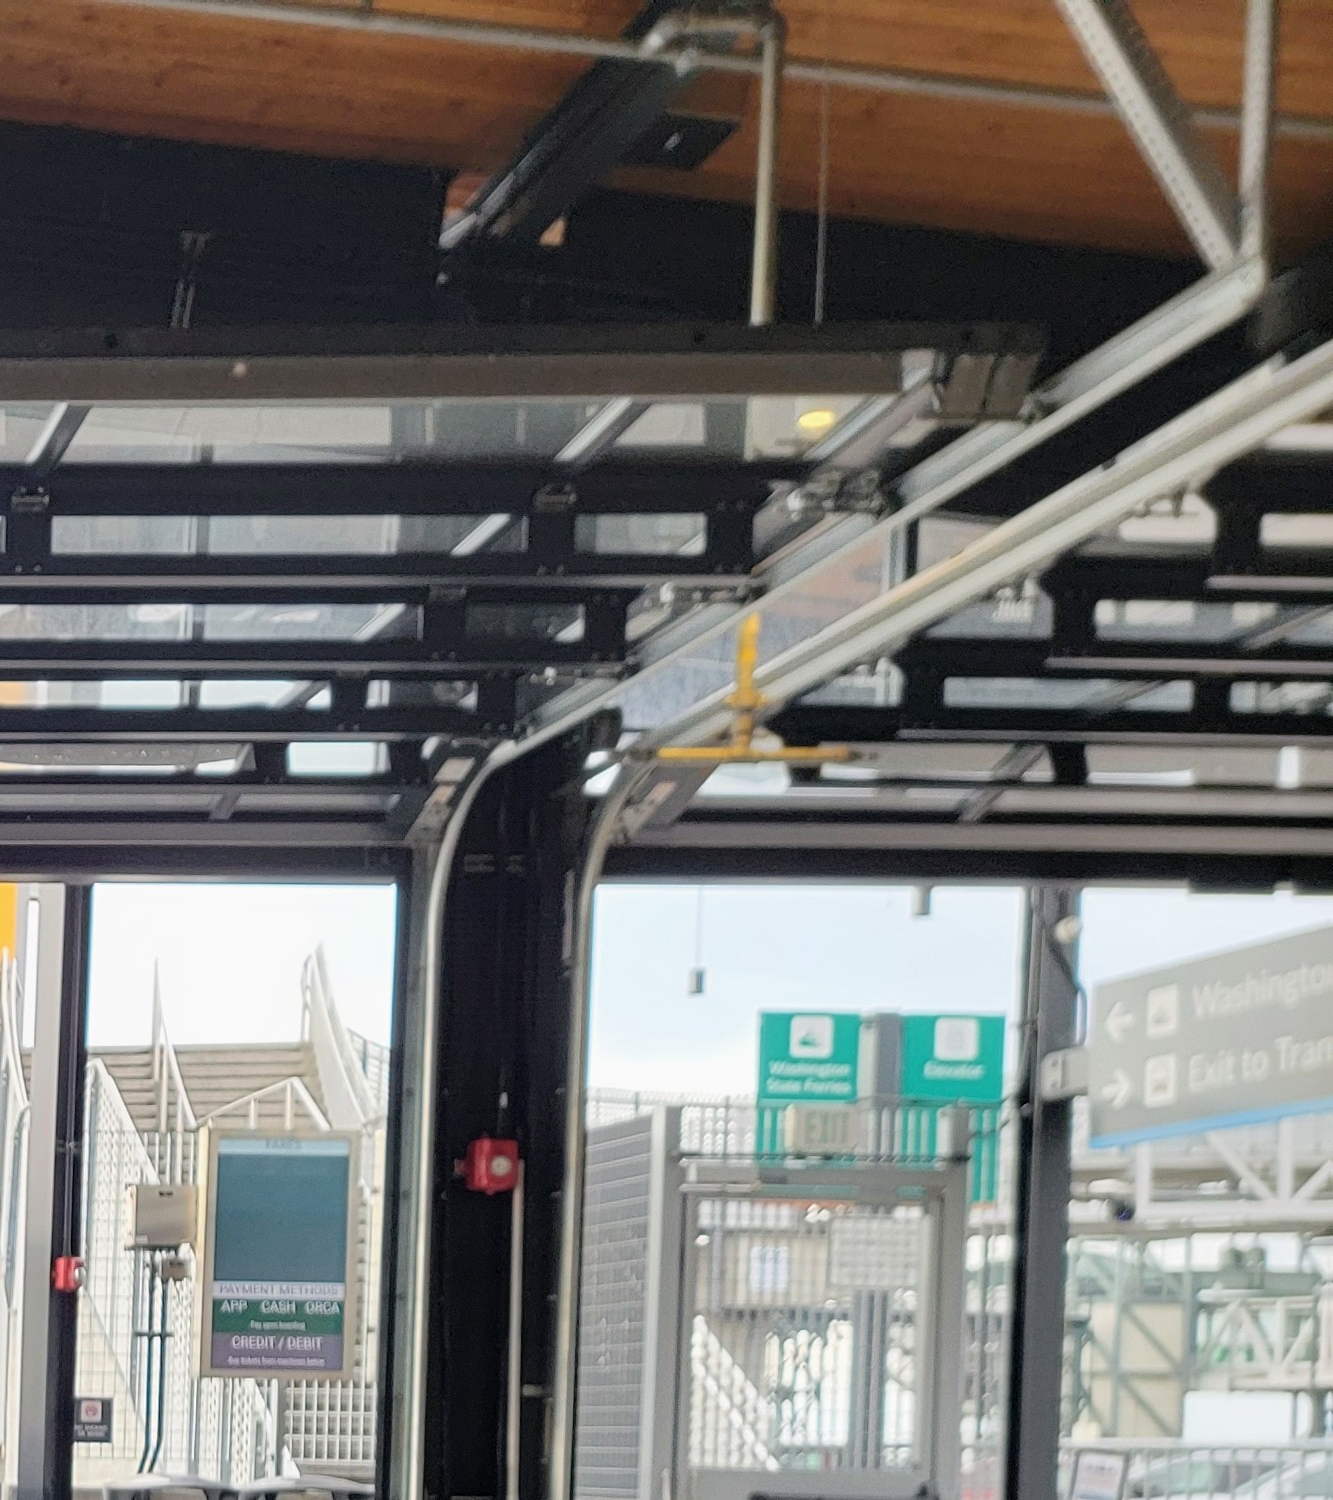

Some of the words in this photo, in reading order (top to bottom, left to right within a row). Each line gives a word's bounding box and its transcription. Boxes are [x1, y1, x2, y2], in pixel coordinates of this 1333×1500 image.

[769, 1060, 852, 1079] Washington
[1188, 1050, 1234, 1093] Exit
[1242, 1049, 1270, 1082] to
[766, 1077, 802, 1094] State
[805, 1109, 849, 1144] EXIT
[219, 1284, 274, 1295] PAYMENT
[279, 1284, 338, 1295] METHODS
[221, 1300, 248, 1313] APP
[261, 1300, 297, 1314] CASH
[305, 1300, 340, 1315] ORCA
[232, 1335, 276, 1350] CREDIT
[278, 1335, 285, 1351] /
[287, 1336, 323, 1351] DEBIT
